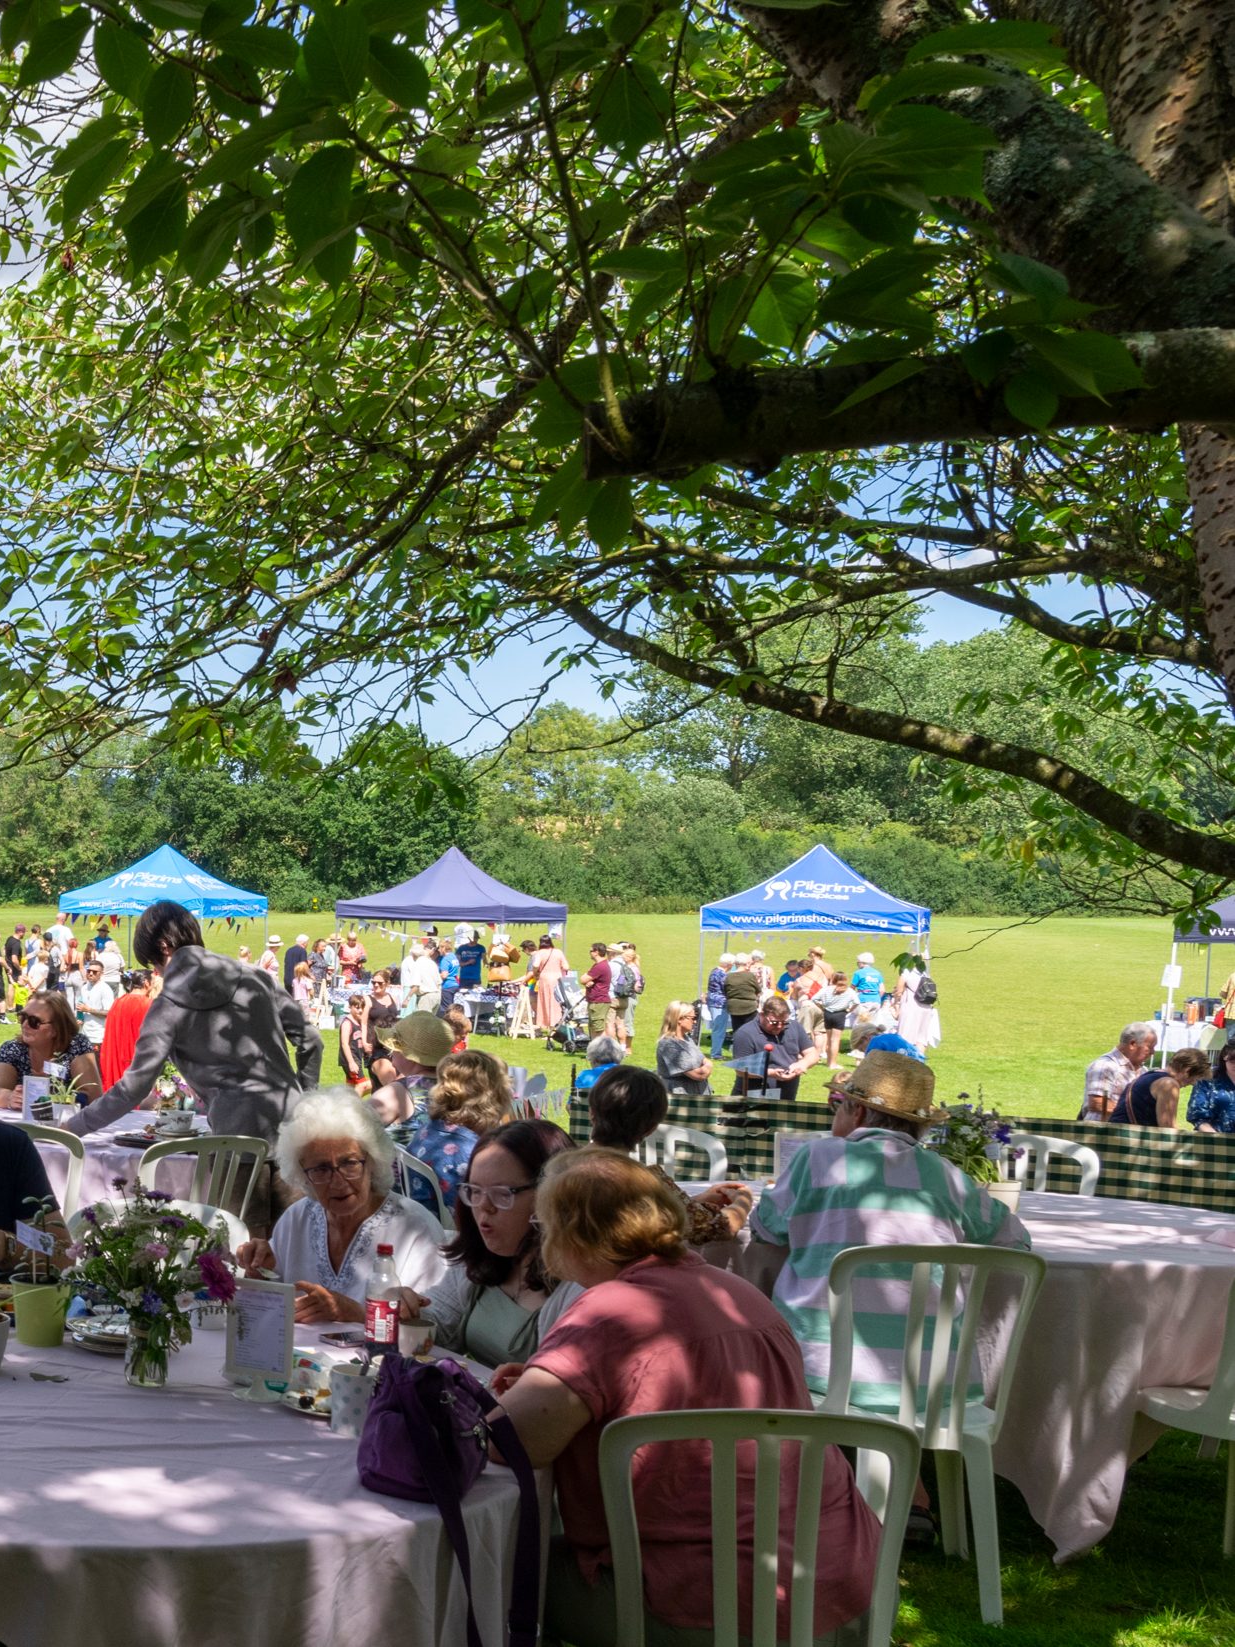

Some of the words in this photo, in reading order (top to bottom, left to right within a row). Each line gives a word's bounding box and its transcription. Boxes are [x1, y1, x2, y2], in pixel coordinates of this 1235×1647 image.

[133, 871, 183, 885] Pilgrims
[793, 880, 867, 894] Pilgrims
[791, 891, 850, 900] Hospices
[730, 914, 889, 928] www.pilgrimshospices.org
